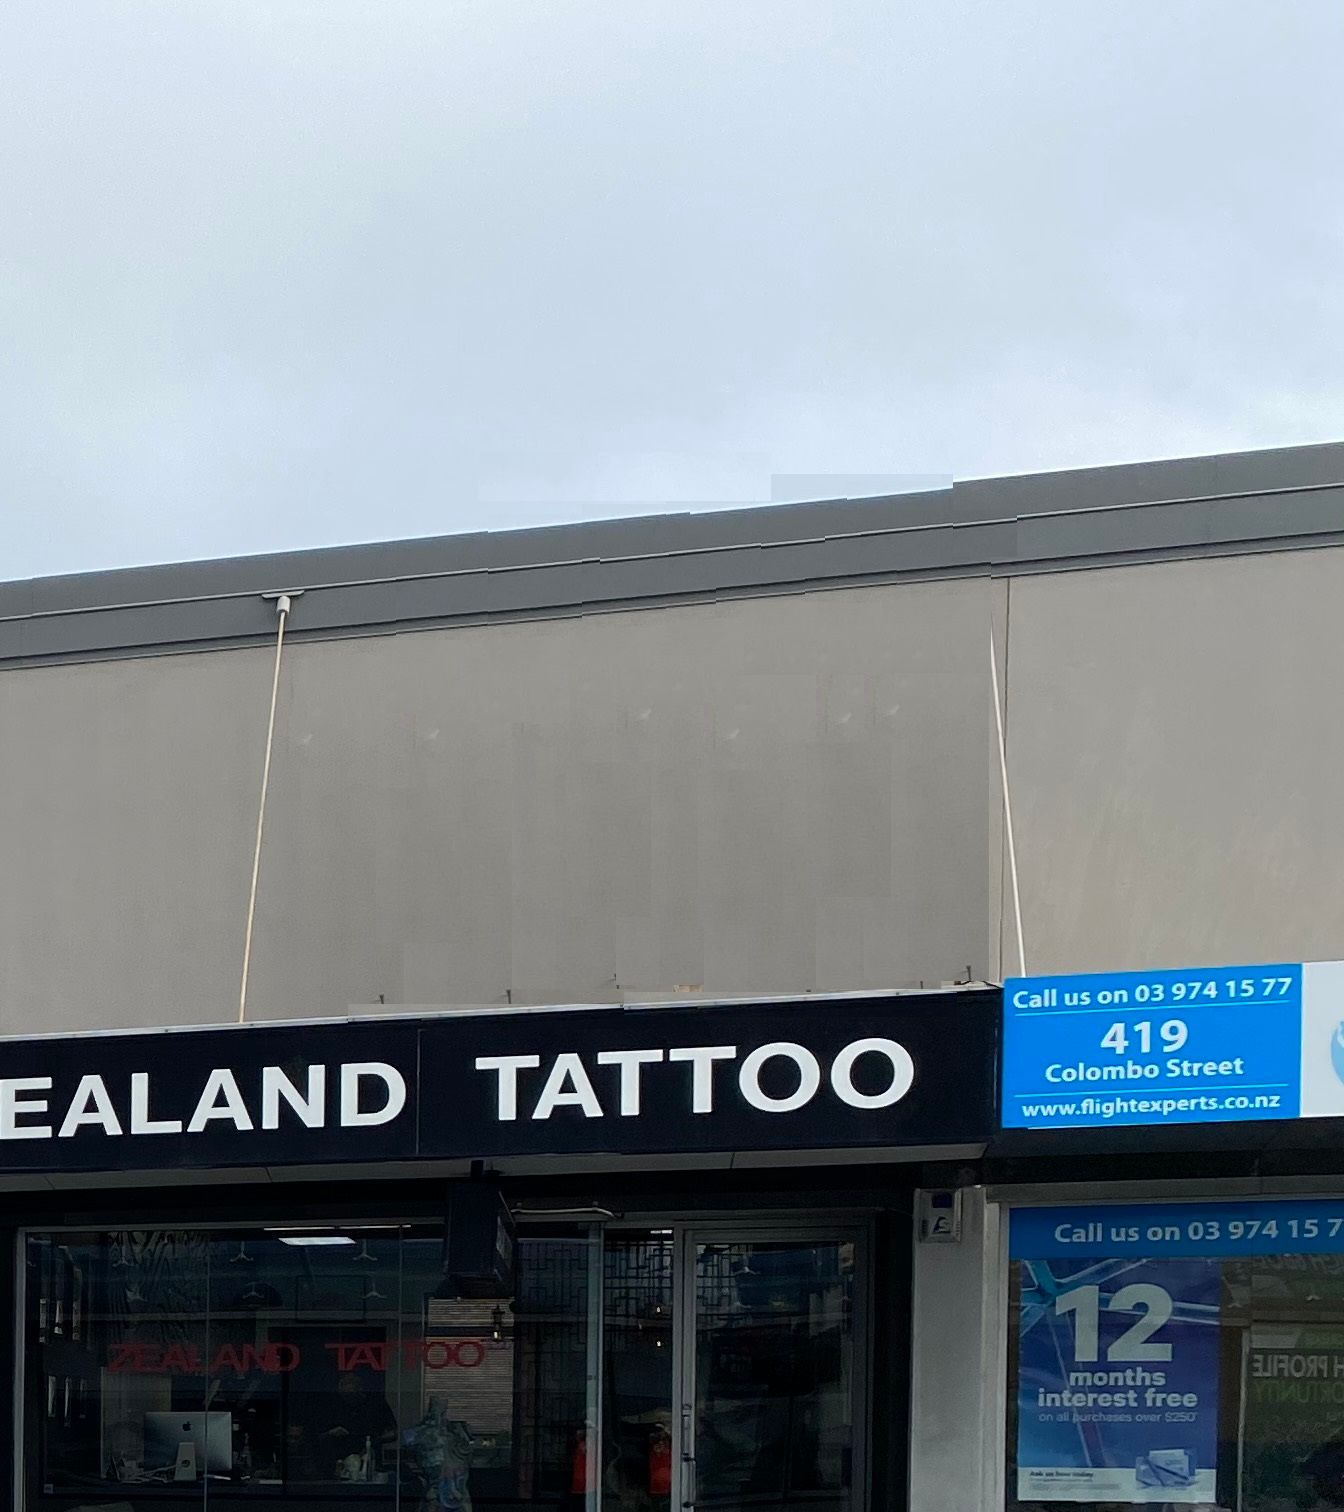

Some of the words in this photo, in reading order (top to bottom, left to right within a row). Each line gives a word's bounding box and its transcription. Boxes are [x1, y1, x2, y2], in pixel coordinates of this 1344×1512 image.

[1013, 989, 1057, 1009] Call
[1064, 990, 1090, 1006] us
[1097, 988, 1128, 1004] on
[1135, 984, 1164, 1001] 03
[1171, 981, 1218, 1000] 974
[1226, 980, 1255, 998] 15
[1262, 977, 1293, 996] 77
[1100, 1020, 1189, 1055] 419
[474, 1037, 915, 1120] TATTOO
[1045, 1060, 1160, 1083] Colombo
[1166, 1057, 1245, 1078] Street
[1021, 1095, 1281, 1117] www.flightexperts.co.nz
[1054, 1223, 1103, 1243] Call
[1111, 1226, 1140, 1242] us
[1147, 1225, 1180, 1241] on
[1188, 1221, 1220, 1241] 03
[1228, 1220, 1279, 1240] 974
[1287, 1219, 1319, 1238] 15
[1327, 1218, 1344, 1238] 7
[1055, 1283, 1173, 1362] 12
[107, 1340, 303, 1374] ZEALAND
[324, 1340, 485, 1372] TATTOO
[1069, 1367, 1166, 1387] months
[1038, 1388, 1138, 1407] interest
[1145, 1388, 1198, 1407] free
[1038, 1413, 1053, 1422] on
[1056, 1411, 1069, 1422] all
[1072, 1411, 1132, 1423] purchases
[1135, 1413, 1162, 1422] over
